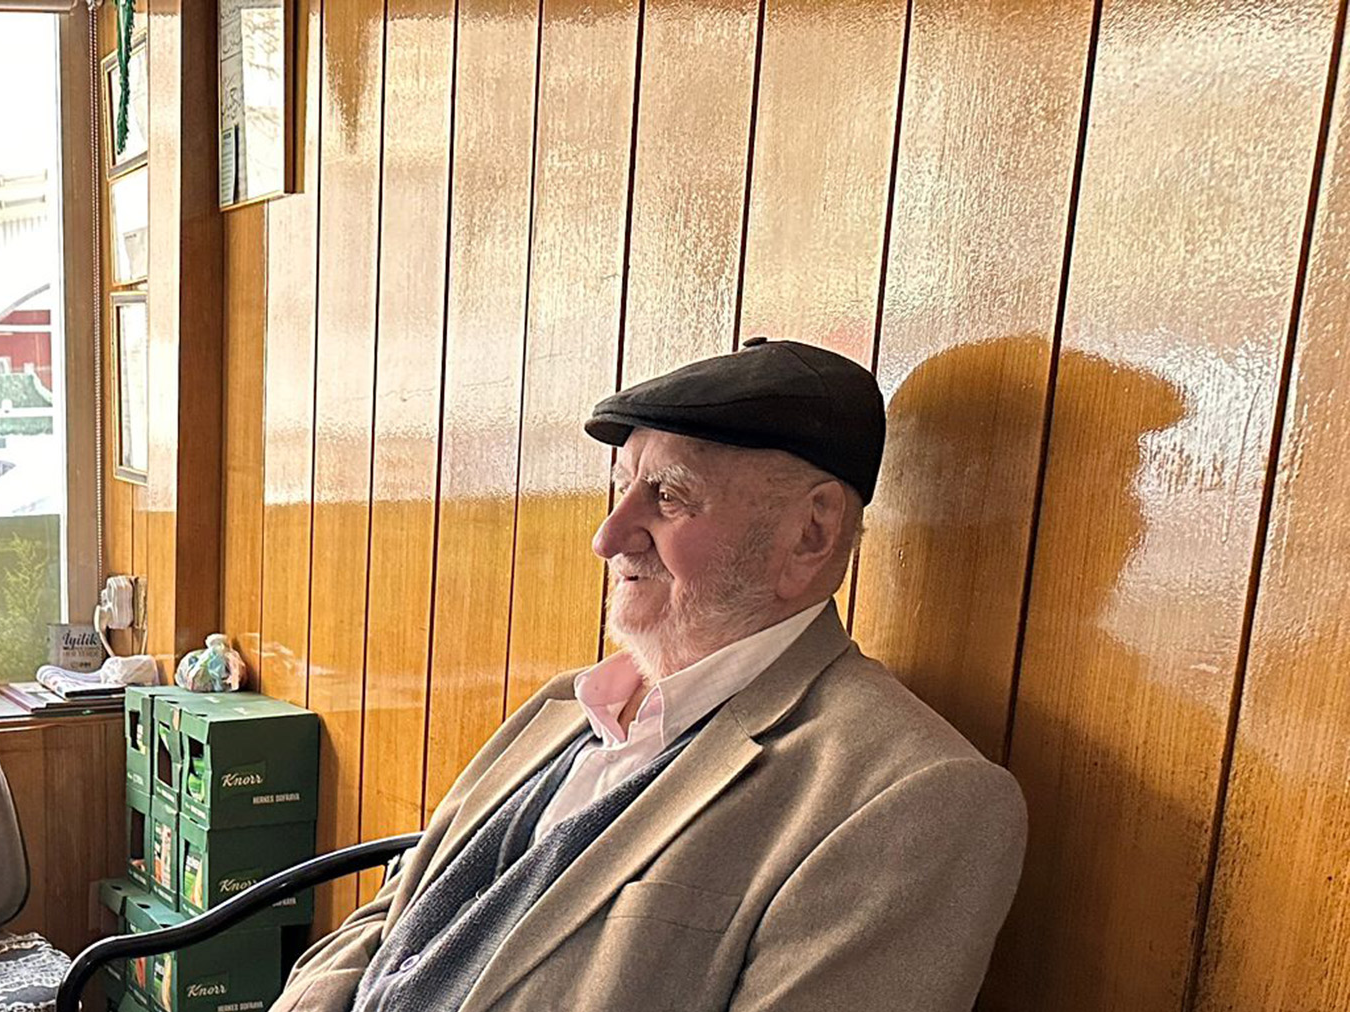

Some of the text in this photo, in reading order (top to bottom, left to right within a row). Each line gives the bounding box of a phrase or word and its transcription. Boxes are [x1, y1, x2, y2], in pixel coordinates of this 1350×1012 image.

[221, 773, 264, 787] Knorr
[219, 879, 257, 893] Knor
[187, 983, 227, 998] Knorr
